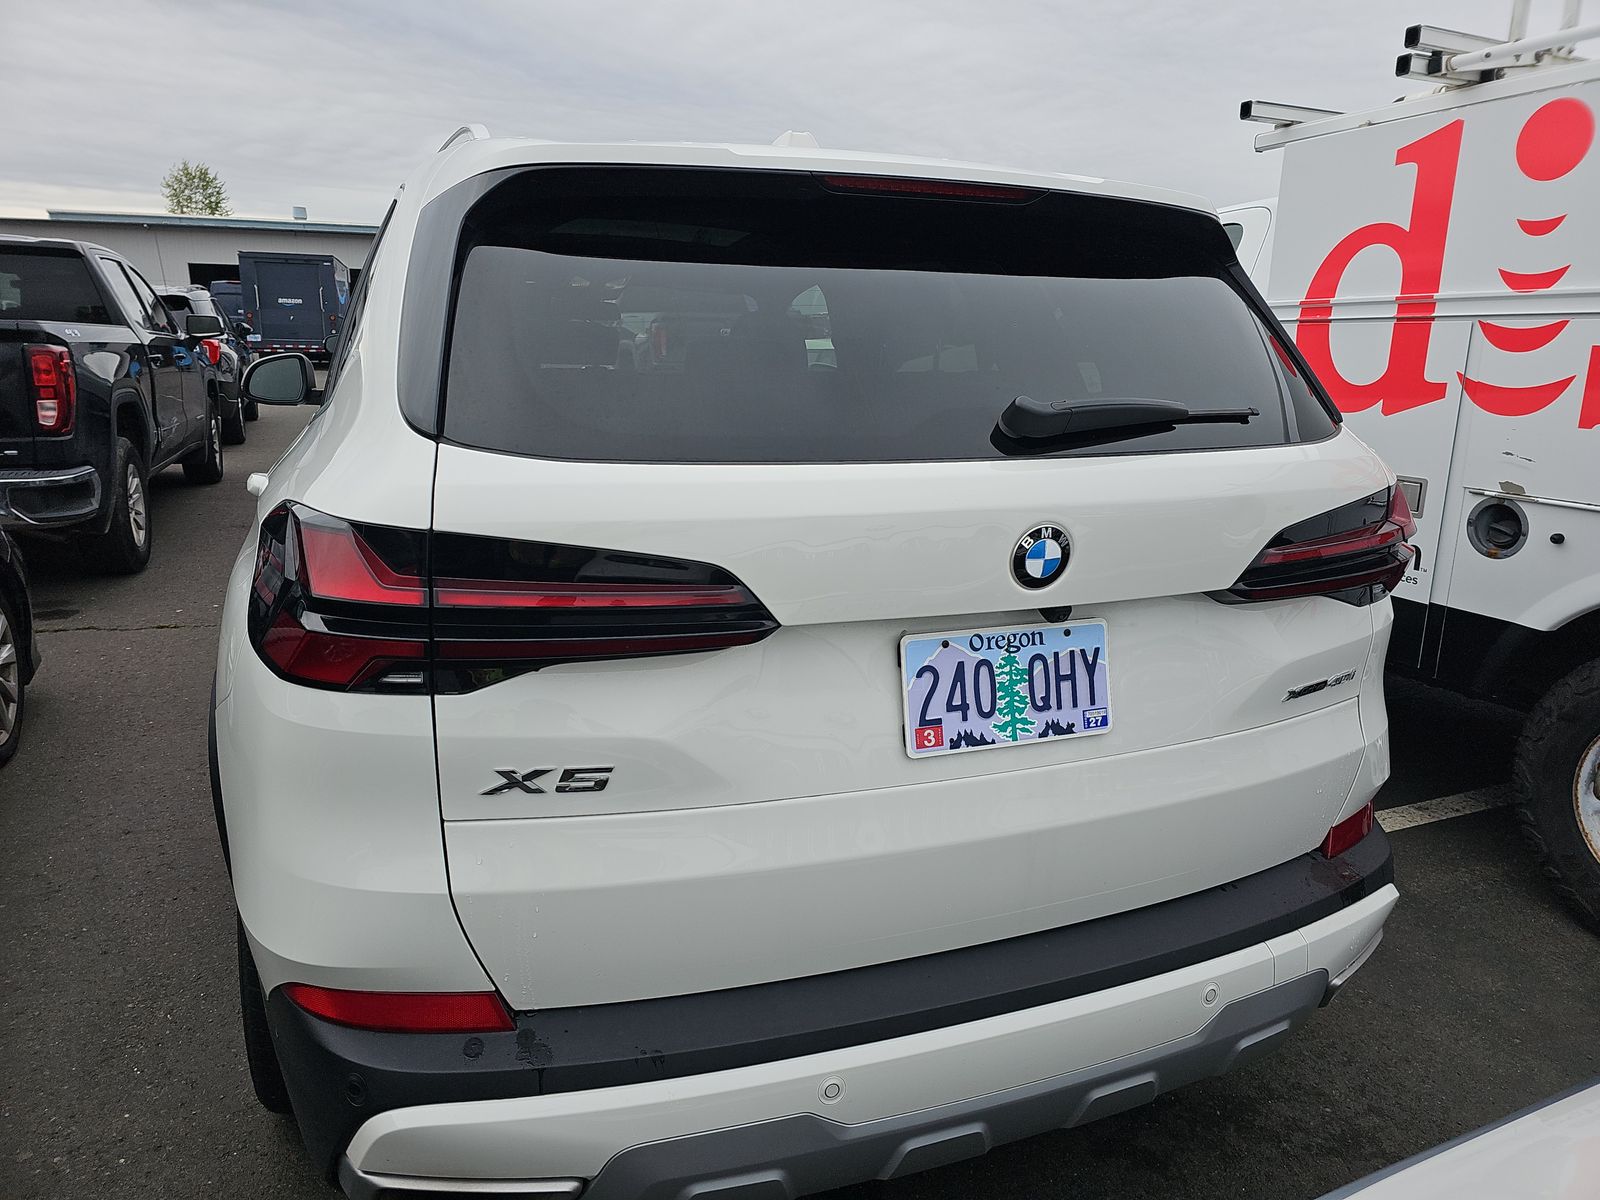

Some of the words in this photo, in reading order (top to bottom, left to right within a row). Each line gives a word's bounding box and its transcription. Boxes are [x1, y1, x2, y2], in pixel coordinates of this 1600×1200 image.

[1296, 97, 1600, 430] di
[277, 297, 303, 305] amazon
[969, 630, 1046, 653] Oregon
[915, 658, 997, 727] 240
[1027, 647, 1101, 713] QHY
[1089, 716, 1103, 727] 27
[923, 729, 936, 747] 3
[479, 765, 616, 796] X5
